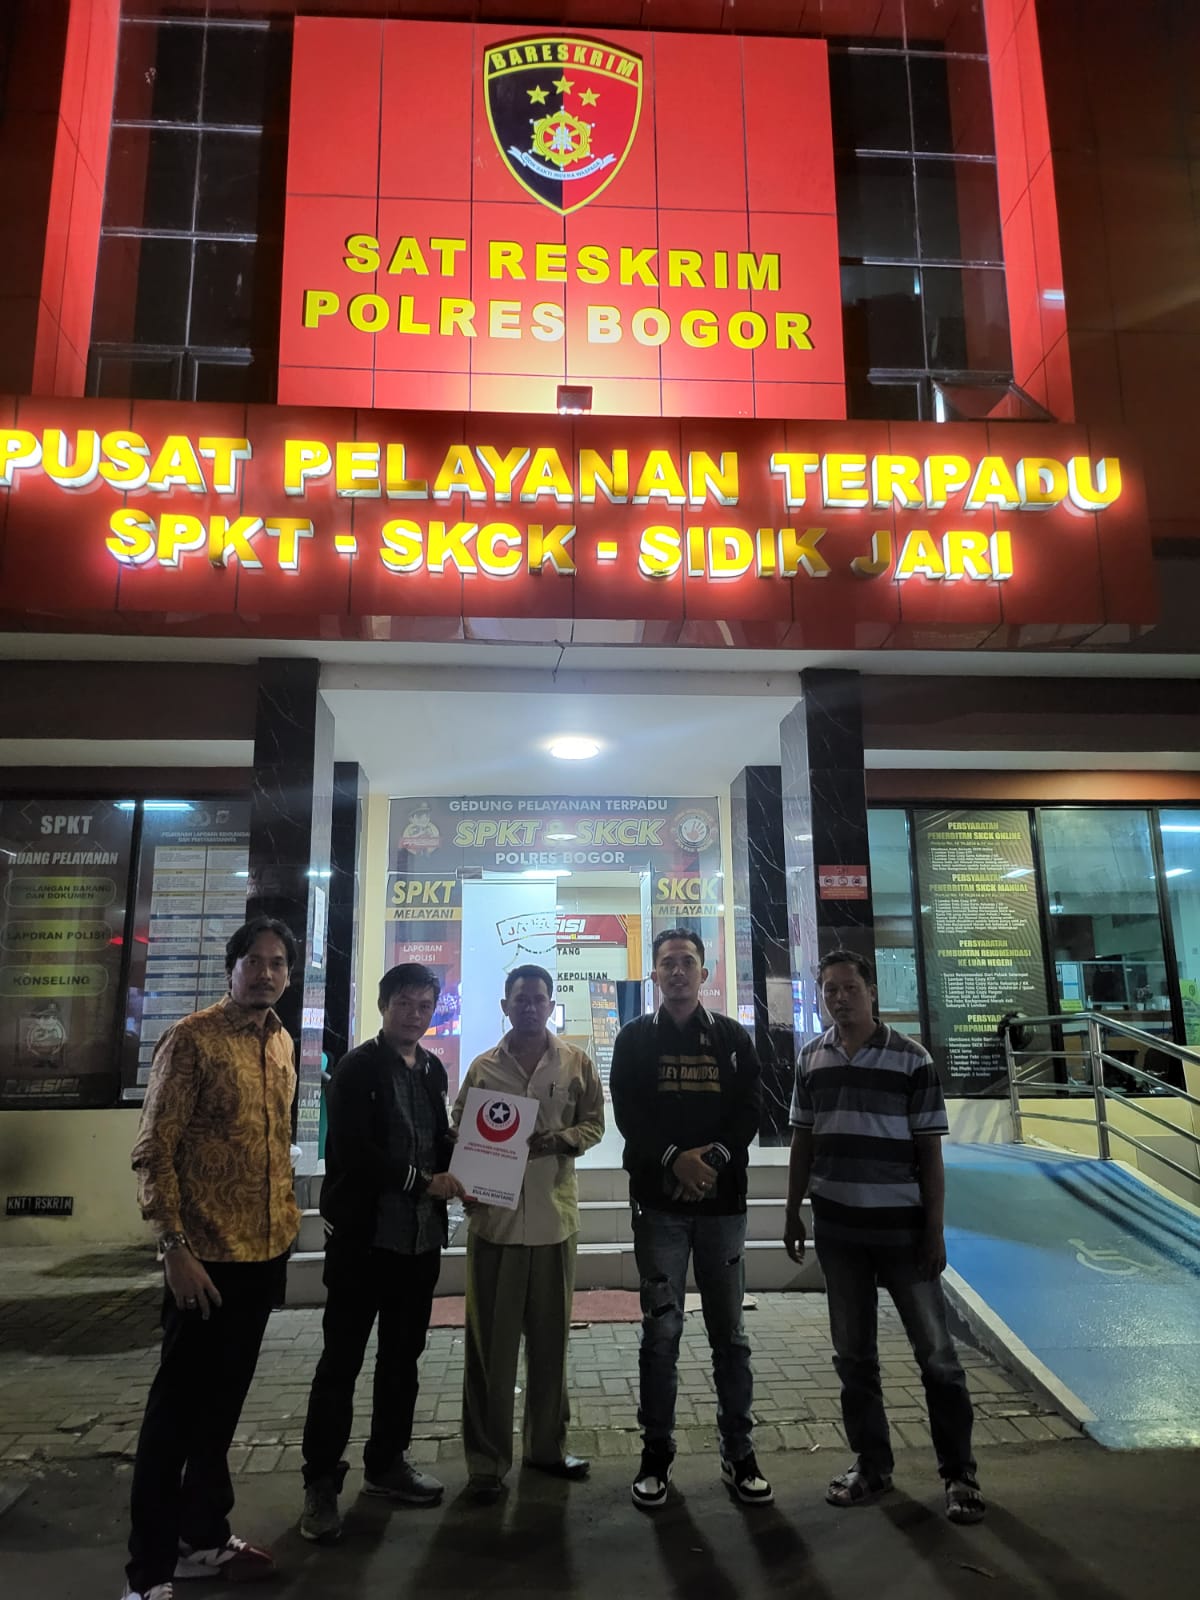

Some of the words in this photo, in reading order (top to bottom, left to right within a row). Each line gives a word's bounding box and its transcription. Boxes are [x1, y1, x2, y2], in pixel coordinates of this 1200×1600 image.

[490, 44, 636, 78] BARESKRIM
[344, 233, 467, 277] SAT
[487, 240, 782, 292] RESKRIM
[303, 289, 566, 344] POLRES
[587, 304, 816, 351] BOGOR
[0, 428, 252, 493] PUSAT
[284, 438, 740, 505] PELAYANAN
[769, 452, 1123, 511] TERPADU
[105, 508, 314, 568] SPKT
[379, 518, 577, 576] SKCK
[638, 524, 832, 578] SIDIK
[849, 529, 1015, 581] JARI
[449, 800, 514, 811] GEDUNG
[518, 800, 601, 811] PELAYANAN
[605, 799, 668, 811] TERPADU
[40, 815, 93, 835] SPKT
[453, 819, 542, 847] SPKT
[575, 818, 666, 846] SKCK
[8, 851, 51, 865] RUANG
[52, 851, 119, 865] PELAYANAN
[495, 852, 557, 865] POLRES
[563, 851, 625, 864] BOGOR
[391, 880, 456, 904] SPKT
[656, 877, 719, 901] SKCK
[393, 908, 455, 919] MELAYANI
[658, 906, 718, 916] MELAYANI
[66, 931, 106, 941] POLISI
[403, 944, 443, 952] LAPORAN
[557, 948, 581, 956] TANG
[409, 954, 436, 962] POLISI
[13, 975, 91, 986] KONSELING
[557, 972, 608, 981] KEPOLISIAN
[967, 1014, 1003, 1023] PERSYAR
[953, 1024, 998, 1033] PERPANJAN
[680, 1065, 720, 1081] DAVIDSO
